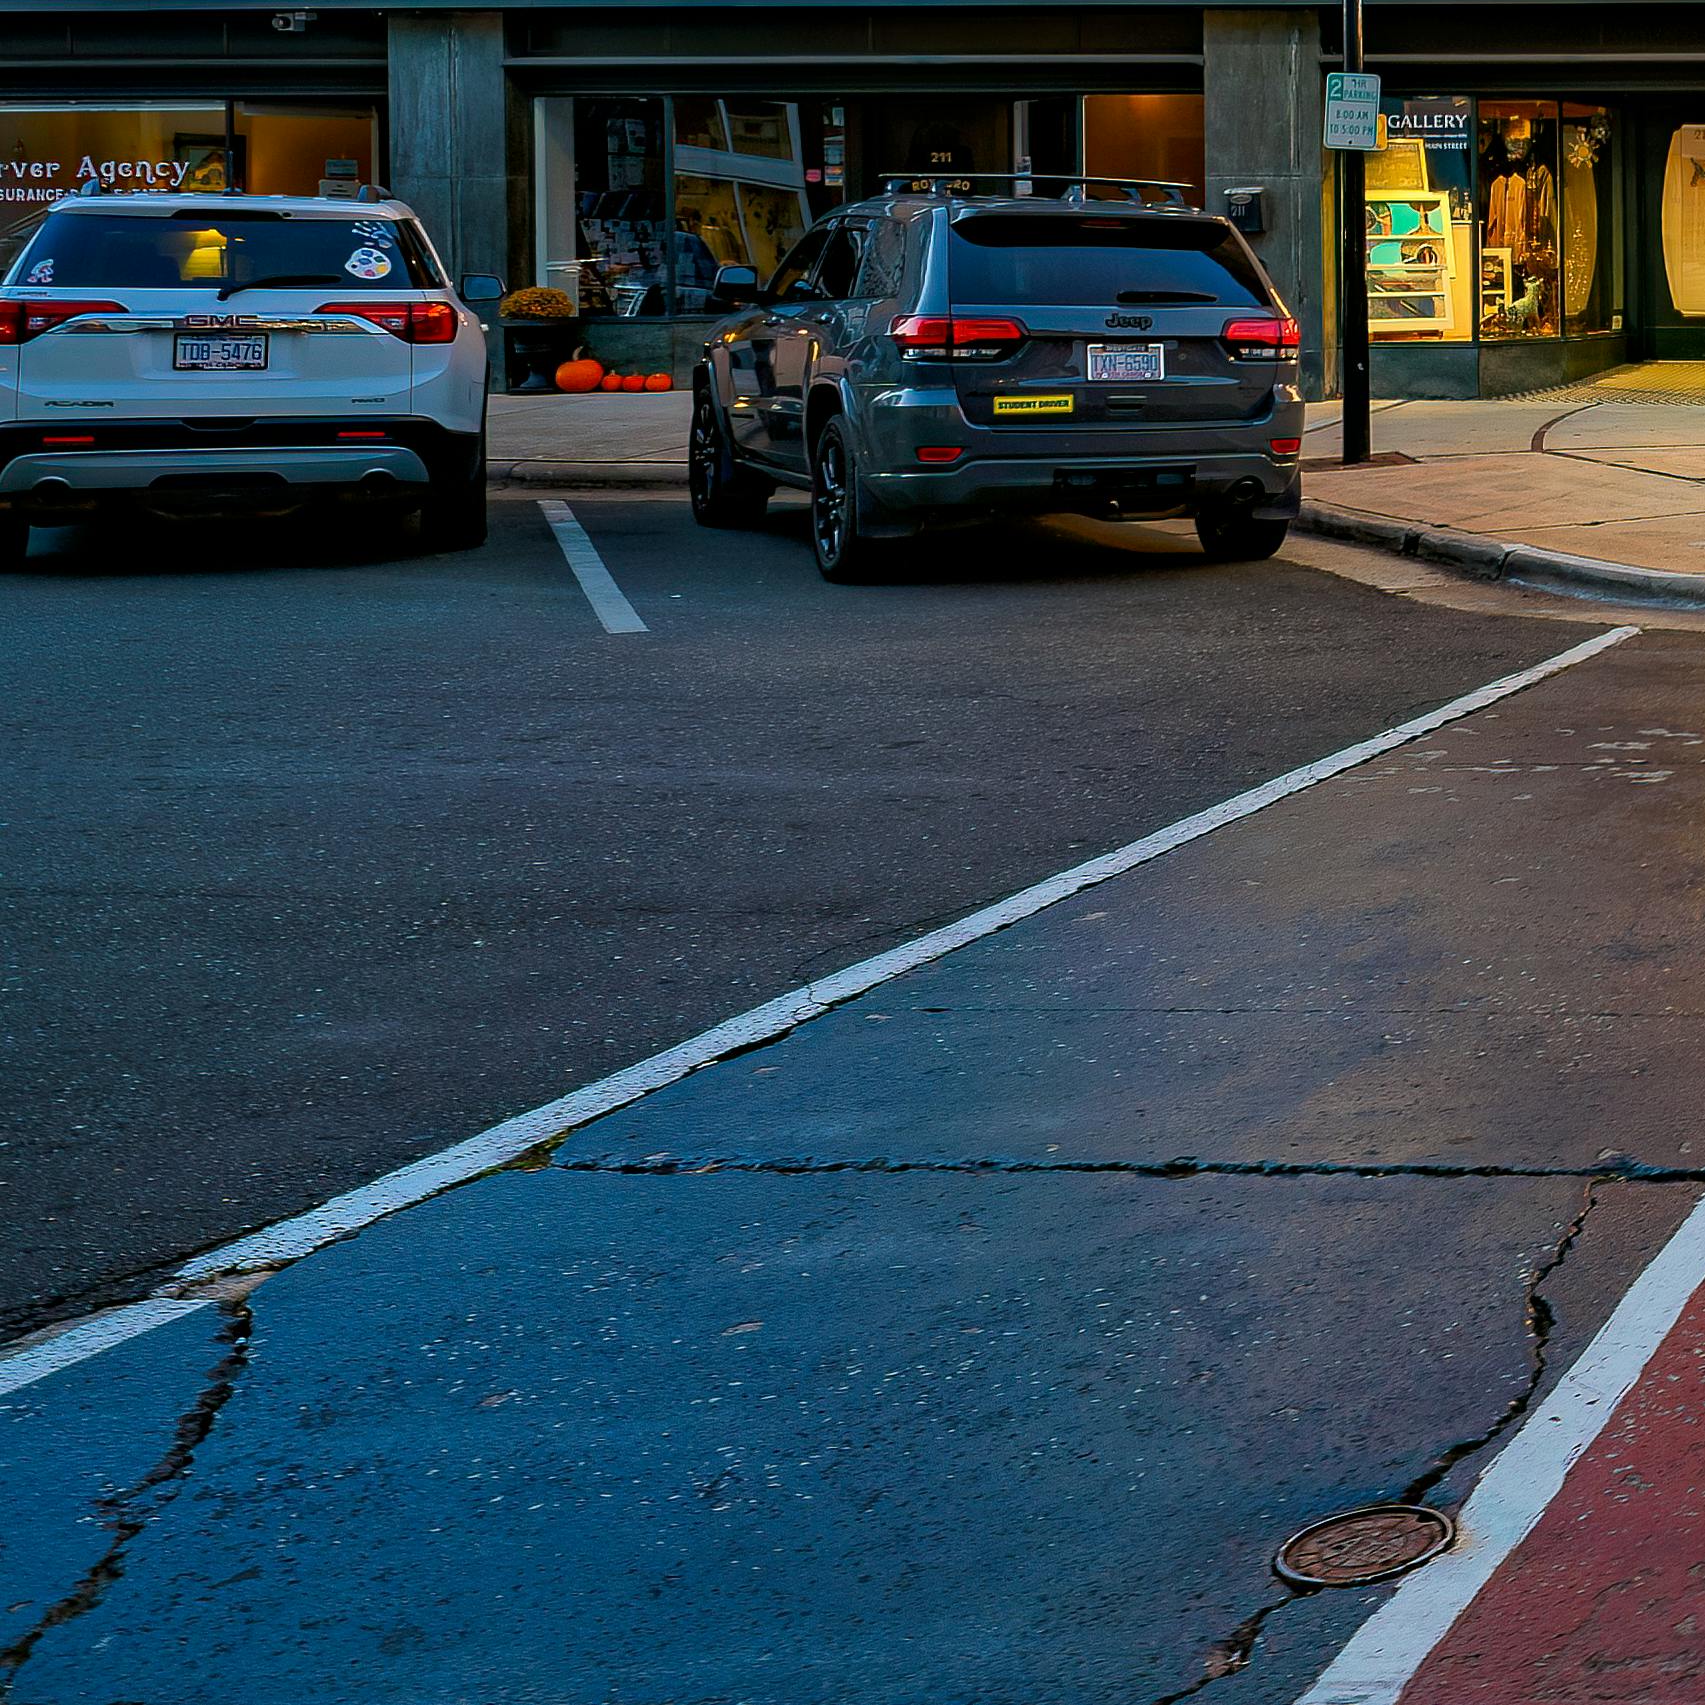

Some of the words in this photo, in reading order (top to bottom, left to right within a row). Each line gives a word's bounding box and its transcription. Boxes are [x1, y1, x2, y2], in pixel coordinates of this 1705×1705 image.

[1330, 79, 1342, 97] 2
[1344, 89, 1377, 100] PARKING
[1356, 110, 1369, 120] AM
[1387, 114, 1468, 129] GALLERY
[76, 155, 190, 187] Agency
[184, 314, 259, 327] GMC
[1105, 313, 1153, 331] Jeep
